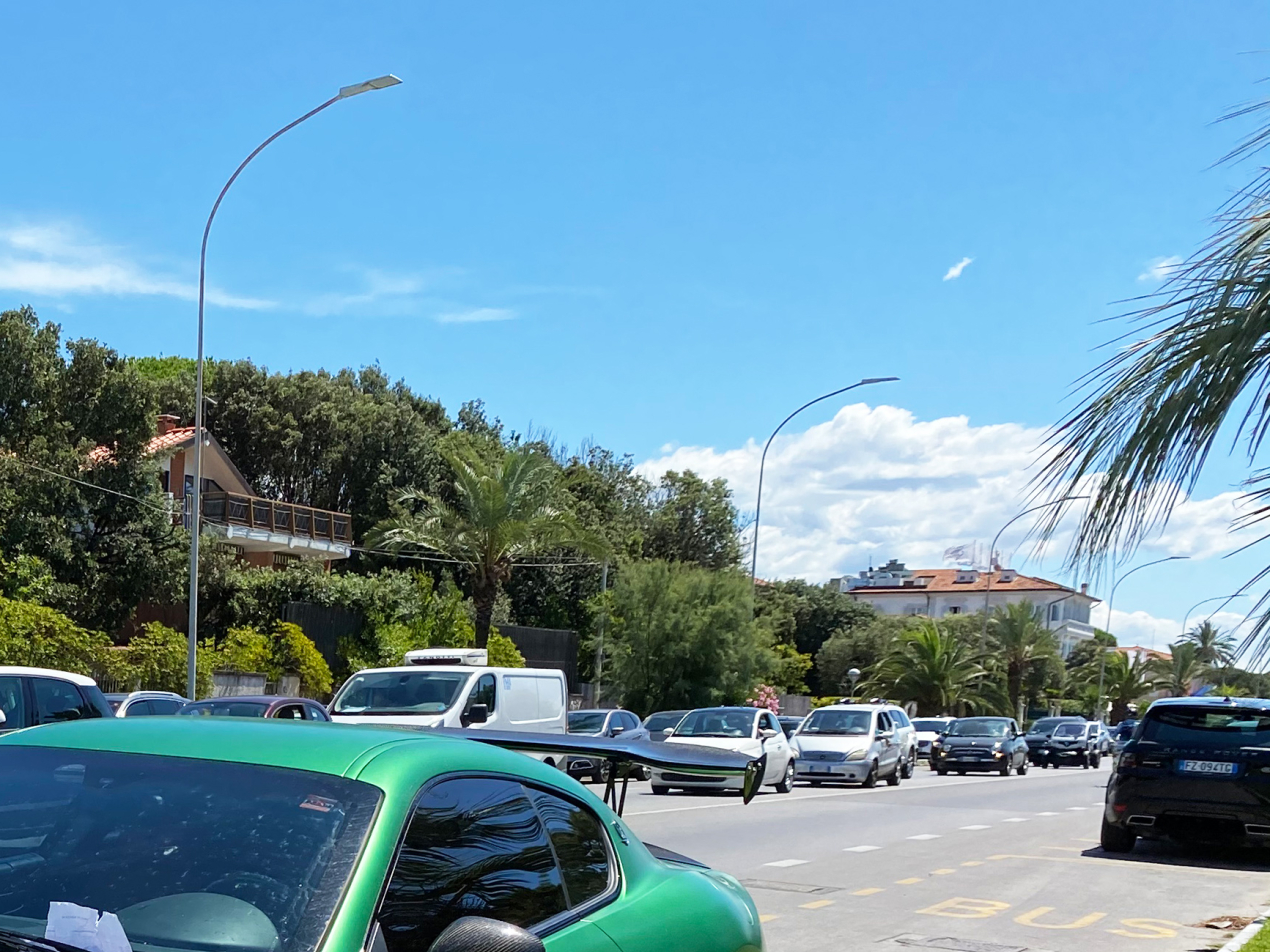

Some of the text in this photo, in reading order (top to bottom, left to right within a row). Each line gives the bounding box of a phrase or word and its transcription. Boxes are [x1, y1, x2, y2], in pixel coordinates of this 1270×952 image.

[1185, 761, 1232, 773] FZ 094TG
[915, 896, 1182, 939] BUS
